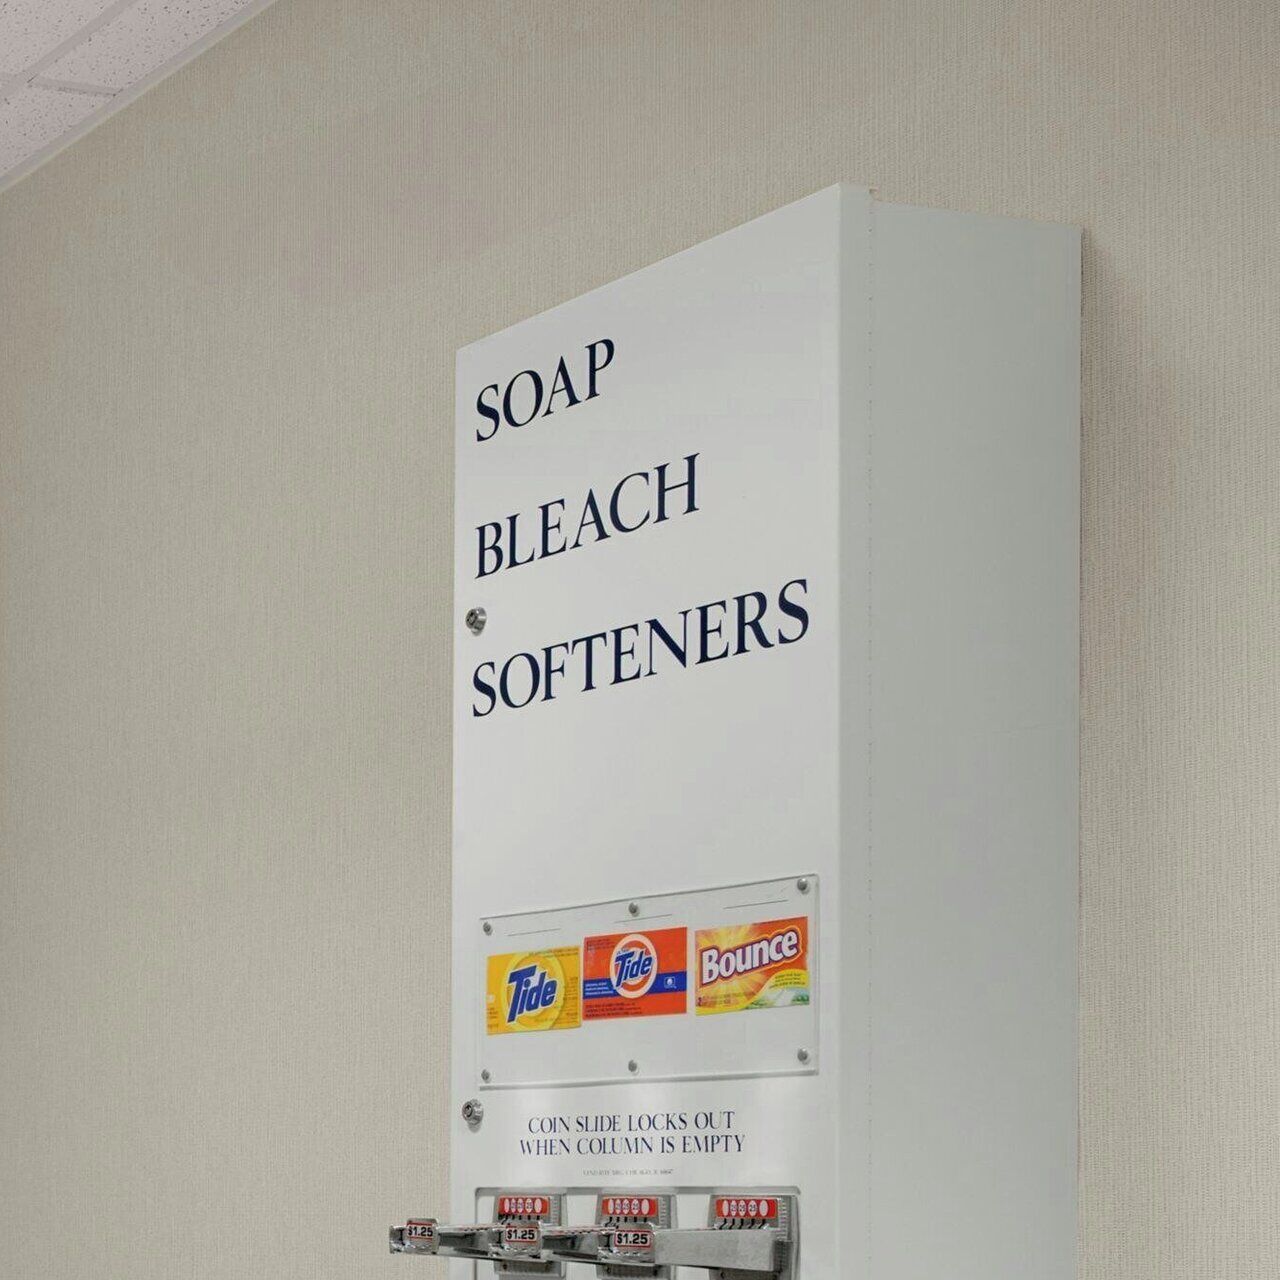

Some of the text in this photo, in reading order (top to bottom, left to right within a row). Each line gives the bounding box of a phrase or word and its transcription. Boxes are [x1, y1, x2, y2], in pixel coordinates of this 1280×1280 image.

[475, 338, 615, 442] SOAP
[474, 452, 700, 580] BLEACH
[472, 578, 810, 718] SOFTENERS
[615, 950, 653, 987] Tide
[701, 931, 798, 985] Bounce
[507, 964, 557, 1023] Tide
[528, 1111, 735, 1134] COIN SLIDE LOCKS OUT
[520, 1134, 745, 1156] WHEN COLUMN IS EMPTY
[408, 1225, 434, 1237] $1.25
[506, 1229, 535, 1240] $1.25
[616, 1233, 648, 1245] $1.25
